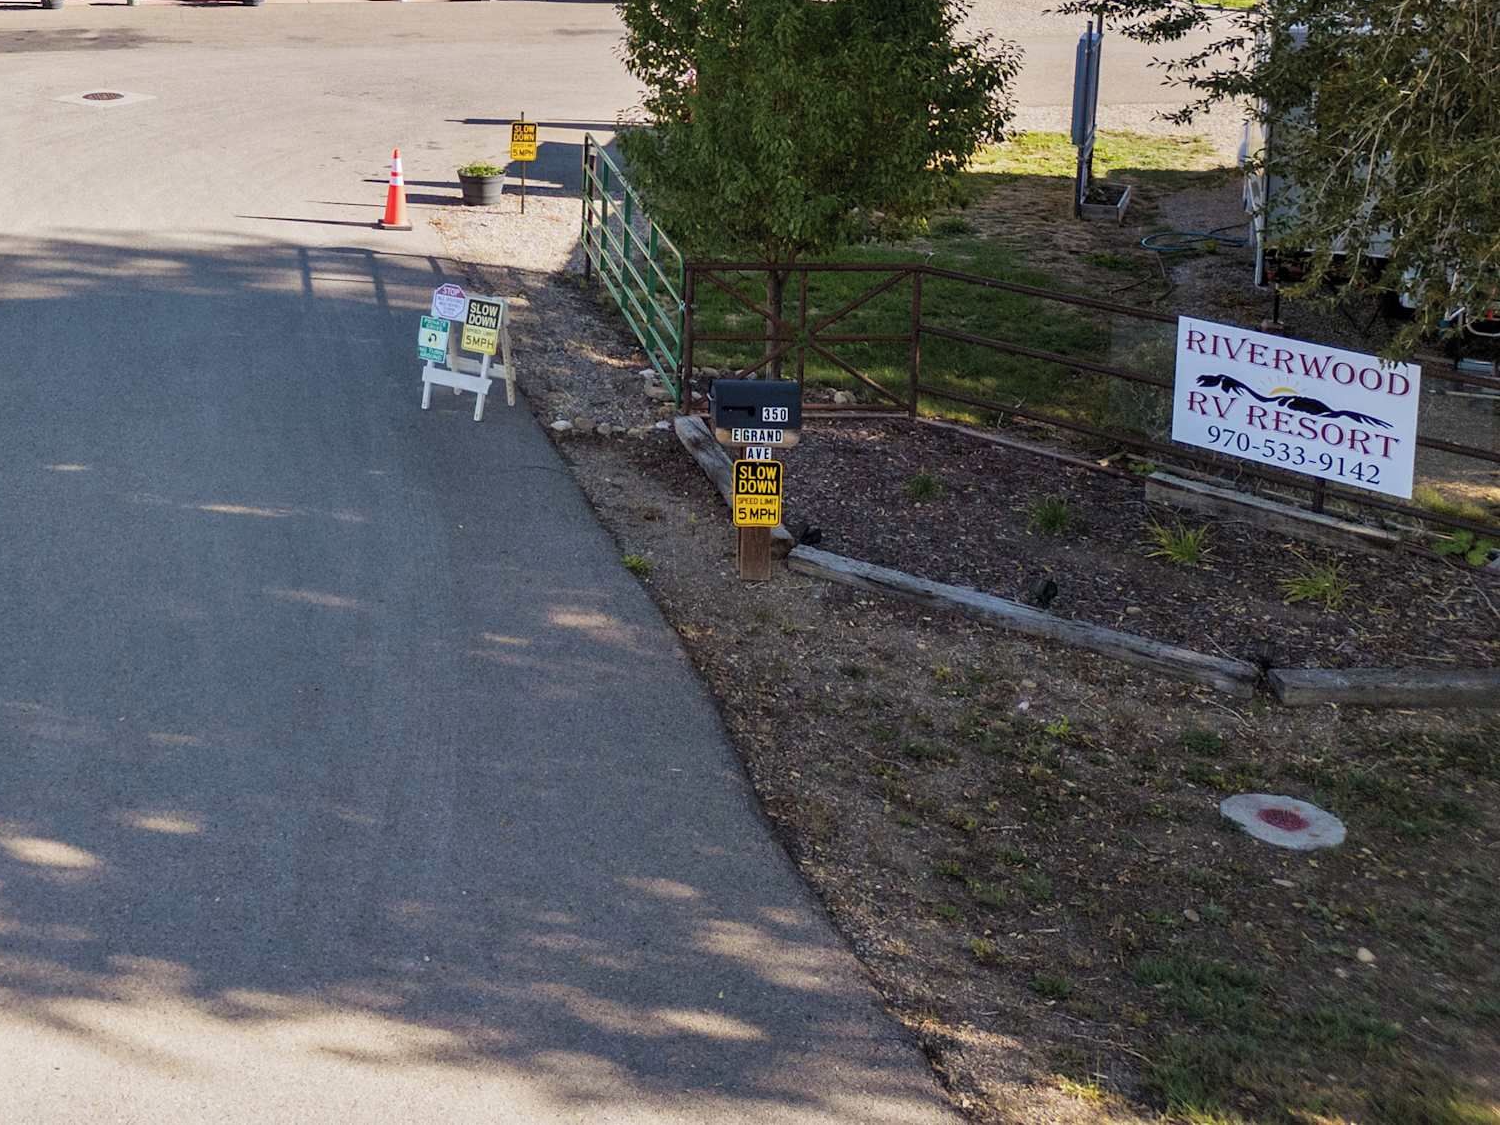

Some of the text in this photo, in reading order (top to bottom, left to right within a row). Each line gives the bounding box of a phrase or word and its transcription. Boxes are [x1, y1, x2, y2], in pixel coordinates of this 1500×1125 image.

[442, 286, 460, 297] STOP
[470, 302, 498, 317] SLOW
[468, 313, 496, 328] DOWN
[1186, 329, 1411, 397] RIVERWOOD
[764, 407, 787, 421] 350
[1186, 391, 1400, 461] RV RESORT
[733, 429, 782, 442] E GRAND
[747, 447, 770, 460] AVE
[1207, 425, 1381, 485] 970-533-9142
[739, 465, 777, 480] SLOW
[738, 479, 777, 494] DOWN
[738, 507, 776, 520] 5 MPH
